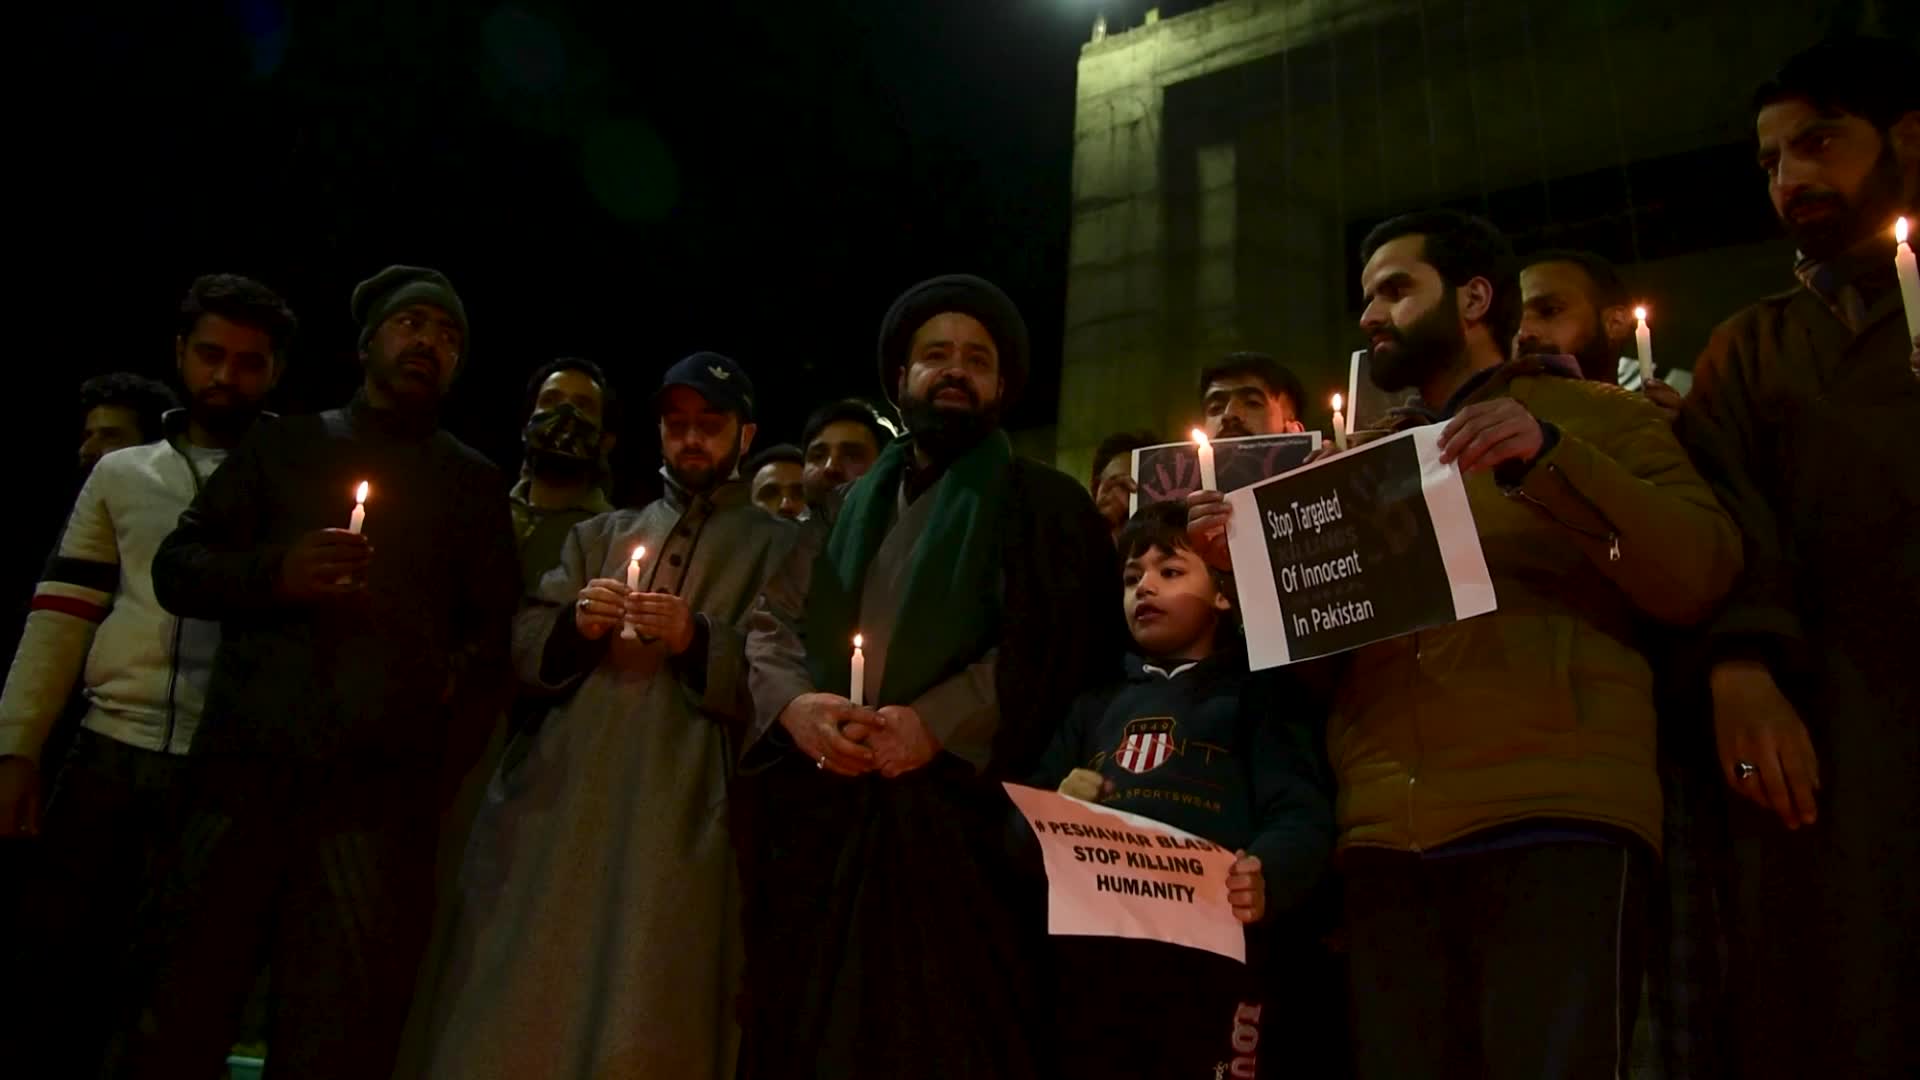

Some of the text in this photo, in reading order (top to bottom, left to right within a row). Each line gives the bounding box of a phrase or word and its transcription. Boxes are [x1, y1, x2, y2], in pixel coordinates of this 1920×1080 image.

[1267, 488, 1343, 542] Stop Targated
[1281, 549, 1362, 593] Of Innocent
[1293, 600, 1375, 637] In Pakistan
[1034, 819, 1046, 833] #
[1049, 821, 1153, 848] PESHAWAR
[1073, 845, 1204, 876] STOP KILLING
[1096, 874, 1195, 904] HUMANITY
